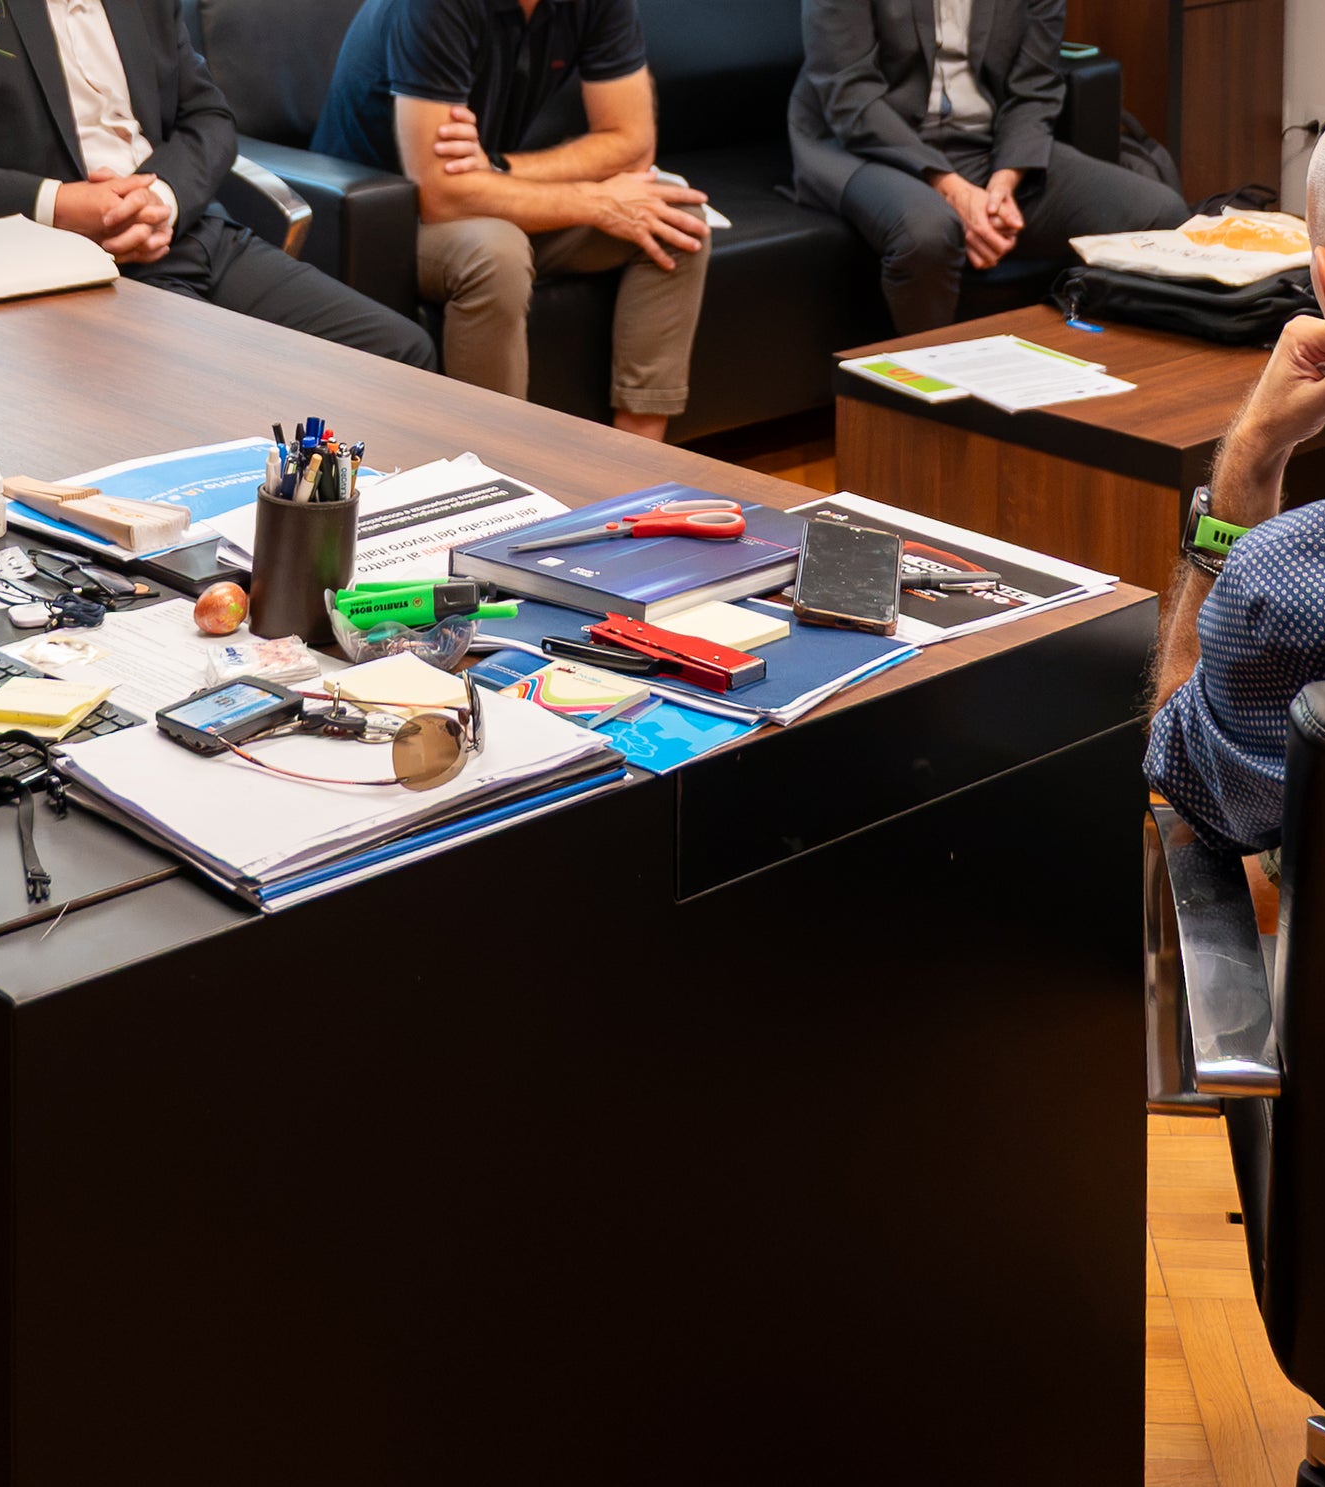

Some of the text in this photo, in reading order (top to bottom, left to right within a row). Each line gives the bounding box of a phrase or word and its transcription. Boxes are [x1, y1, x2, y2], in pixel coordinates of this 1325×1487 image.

[515, 507, 538, 519] del
[458, 512, 515, 533] mercato
[389, 531, 437, 551] lavoro
[438, 526, 456, 539] del
[357, 554, 407, 573] centro
[349, 600, 409, 617] STABILO BOSS
